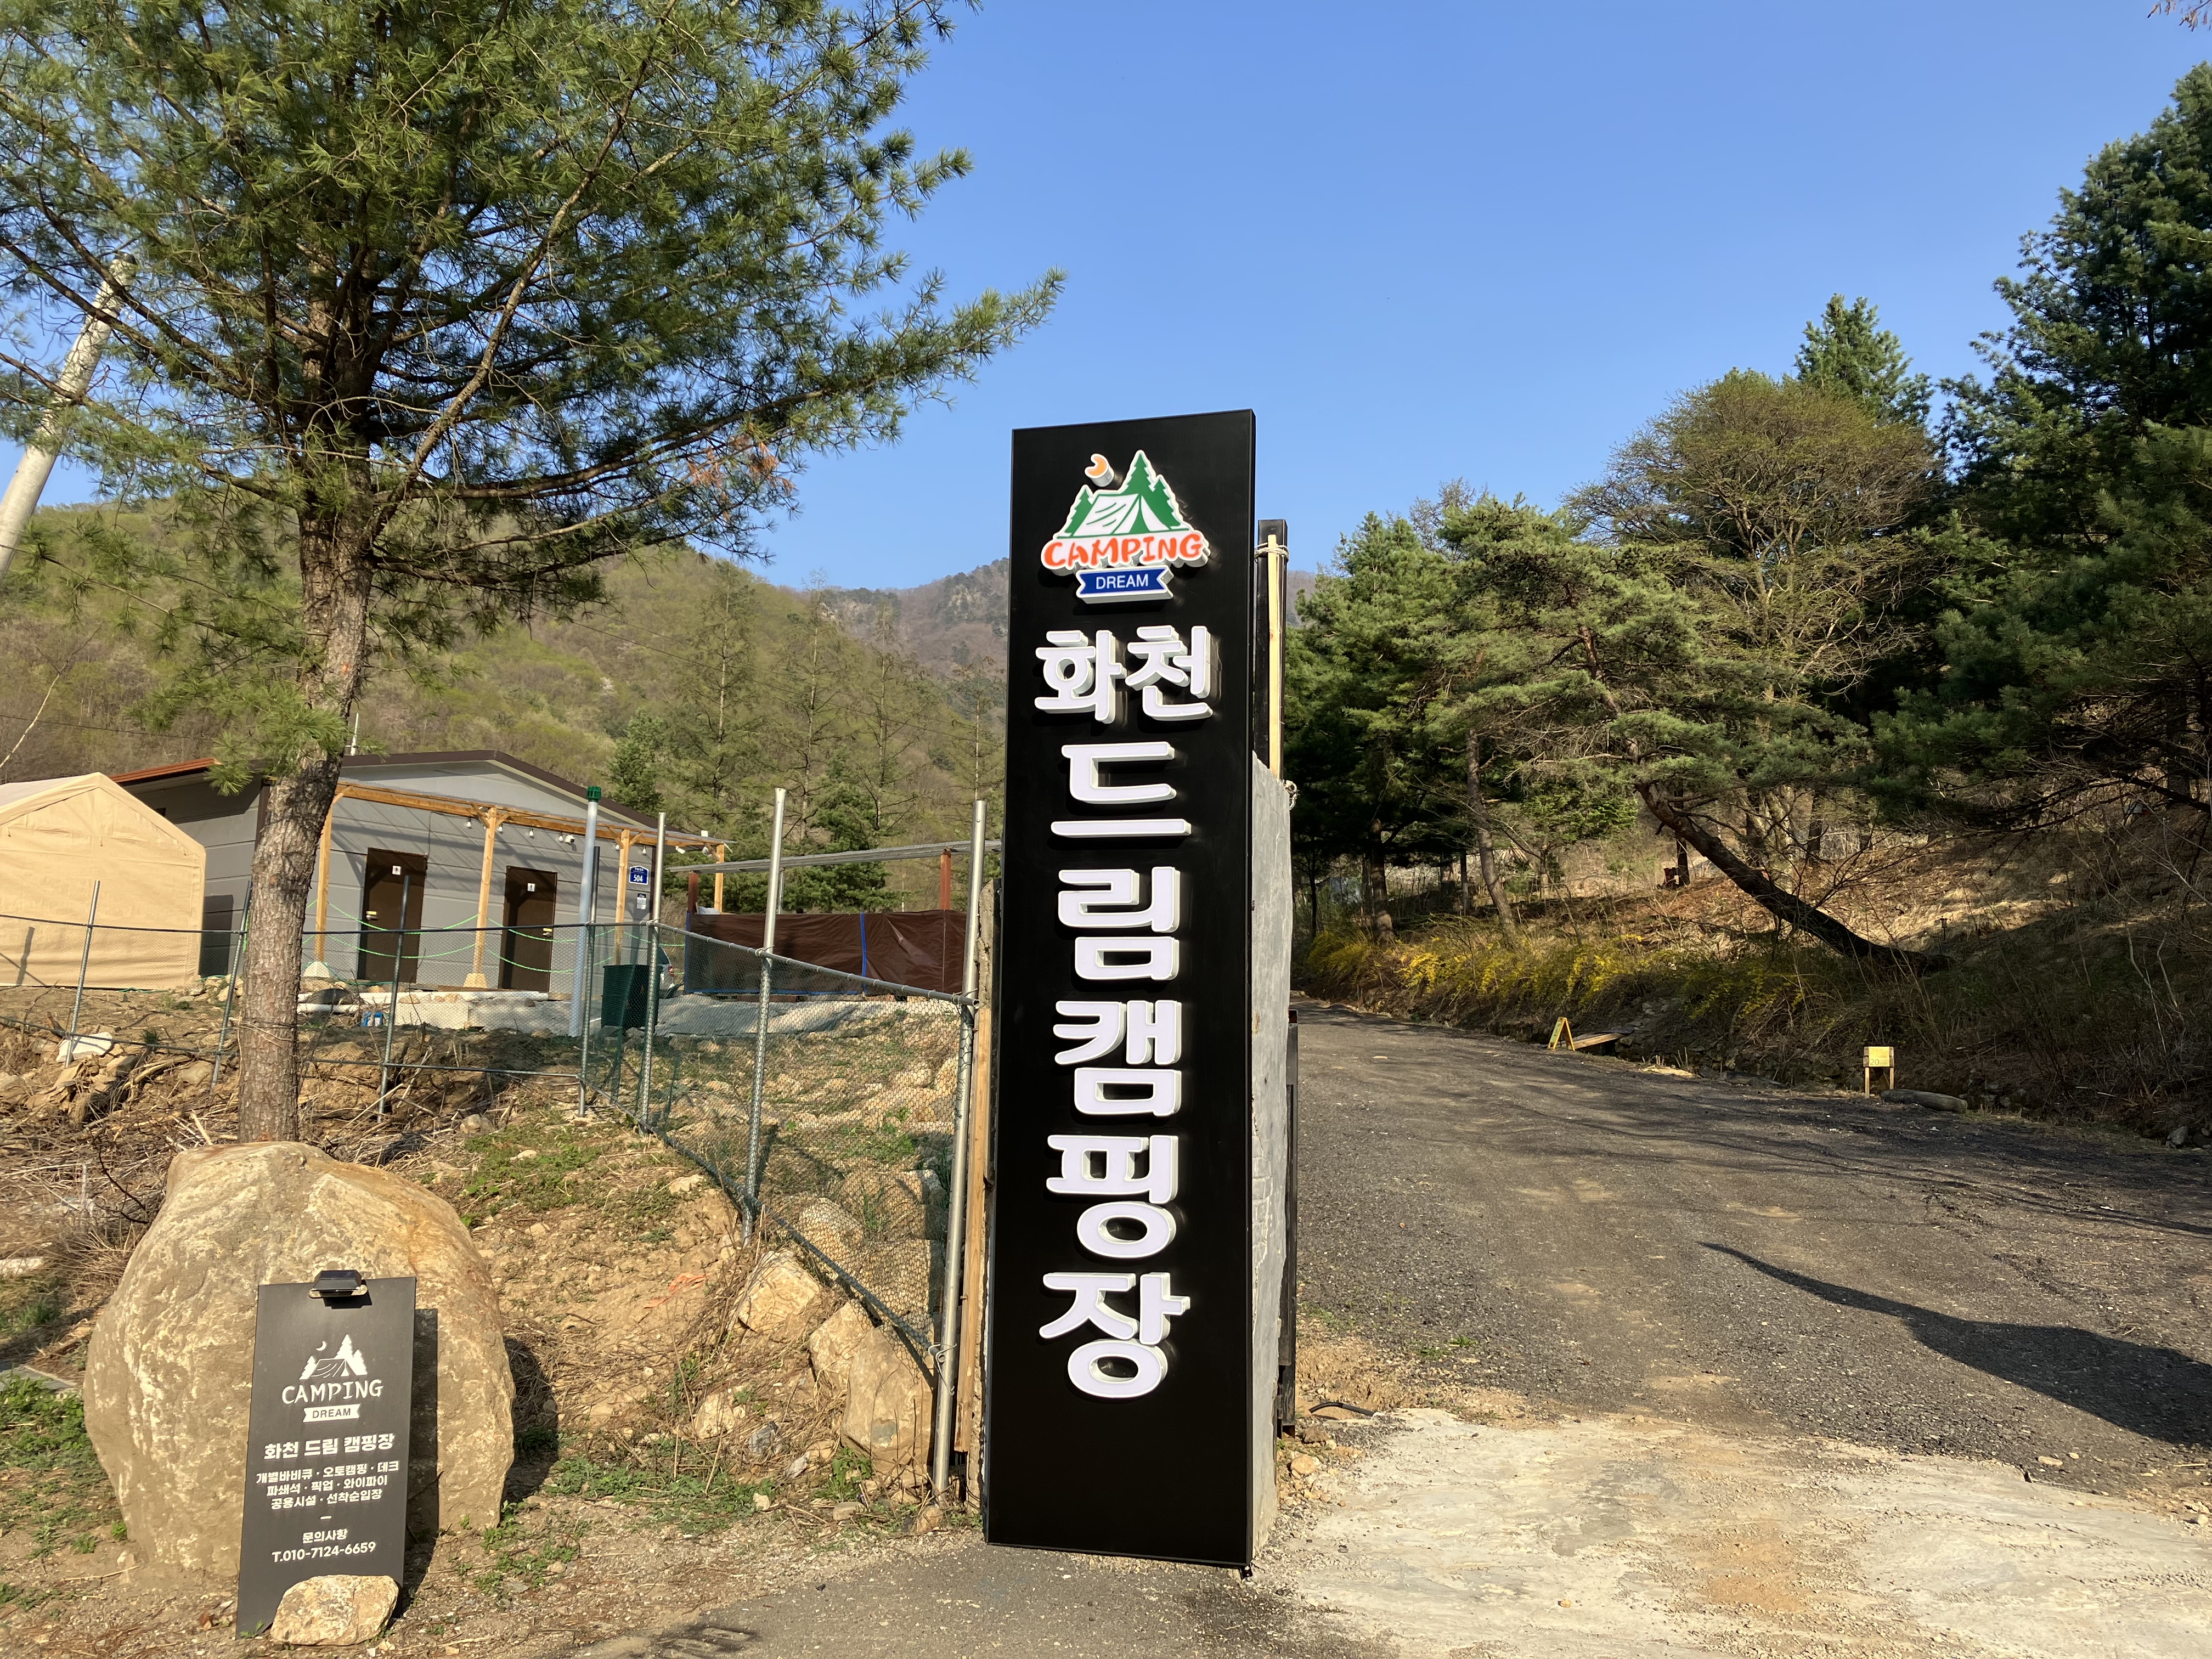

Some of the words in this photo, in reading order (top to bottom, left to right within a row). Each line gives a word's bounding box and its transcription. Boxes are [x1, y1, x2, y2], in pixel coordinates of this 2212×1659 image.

[1043, 533, 1203, 567] CAMPING
[1096, 574, 1148, 590] DREAM
[1035, 625, 1213, 724] 화천
[634, 874, 643, 882] 504
[282, 1379, 383, 1404] CAMPING
[313, 1408, 351, 1418] DREAM
[264, 1442, 298, 1459] 화천
[304, 1438, 338, 1455] 드림
[344, 1434, 395, 1453] 캠핑장
[256, 1469, 312, 1483] 개별바비큐
[323, 1464, 367, 1477] 오토캠핑
[377, 1461, 399, 1472] 데크
[267, 1483, 301, 1496] 파쇄석
[311, 1480, 333, 1491] 픽업
[343, 1475, 387, 1488] 와이파이
[271, 1495, 316, 1510] 공용시설
[327, 1489, 382, 1504] 선착순입장
[302, 1528, 348, 1544] 문의사항
[272, 1542, 376, 1562] T.010-7124-6659
